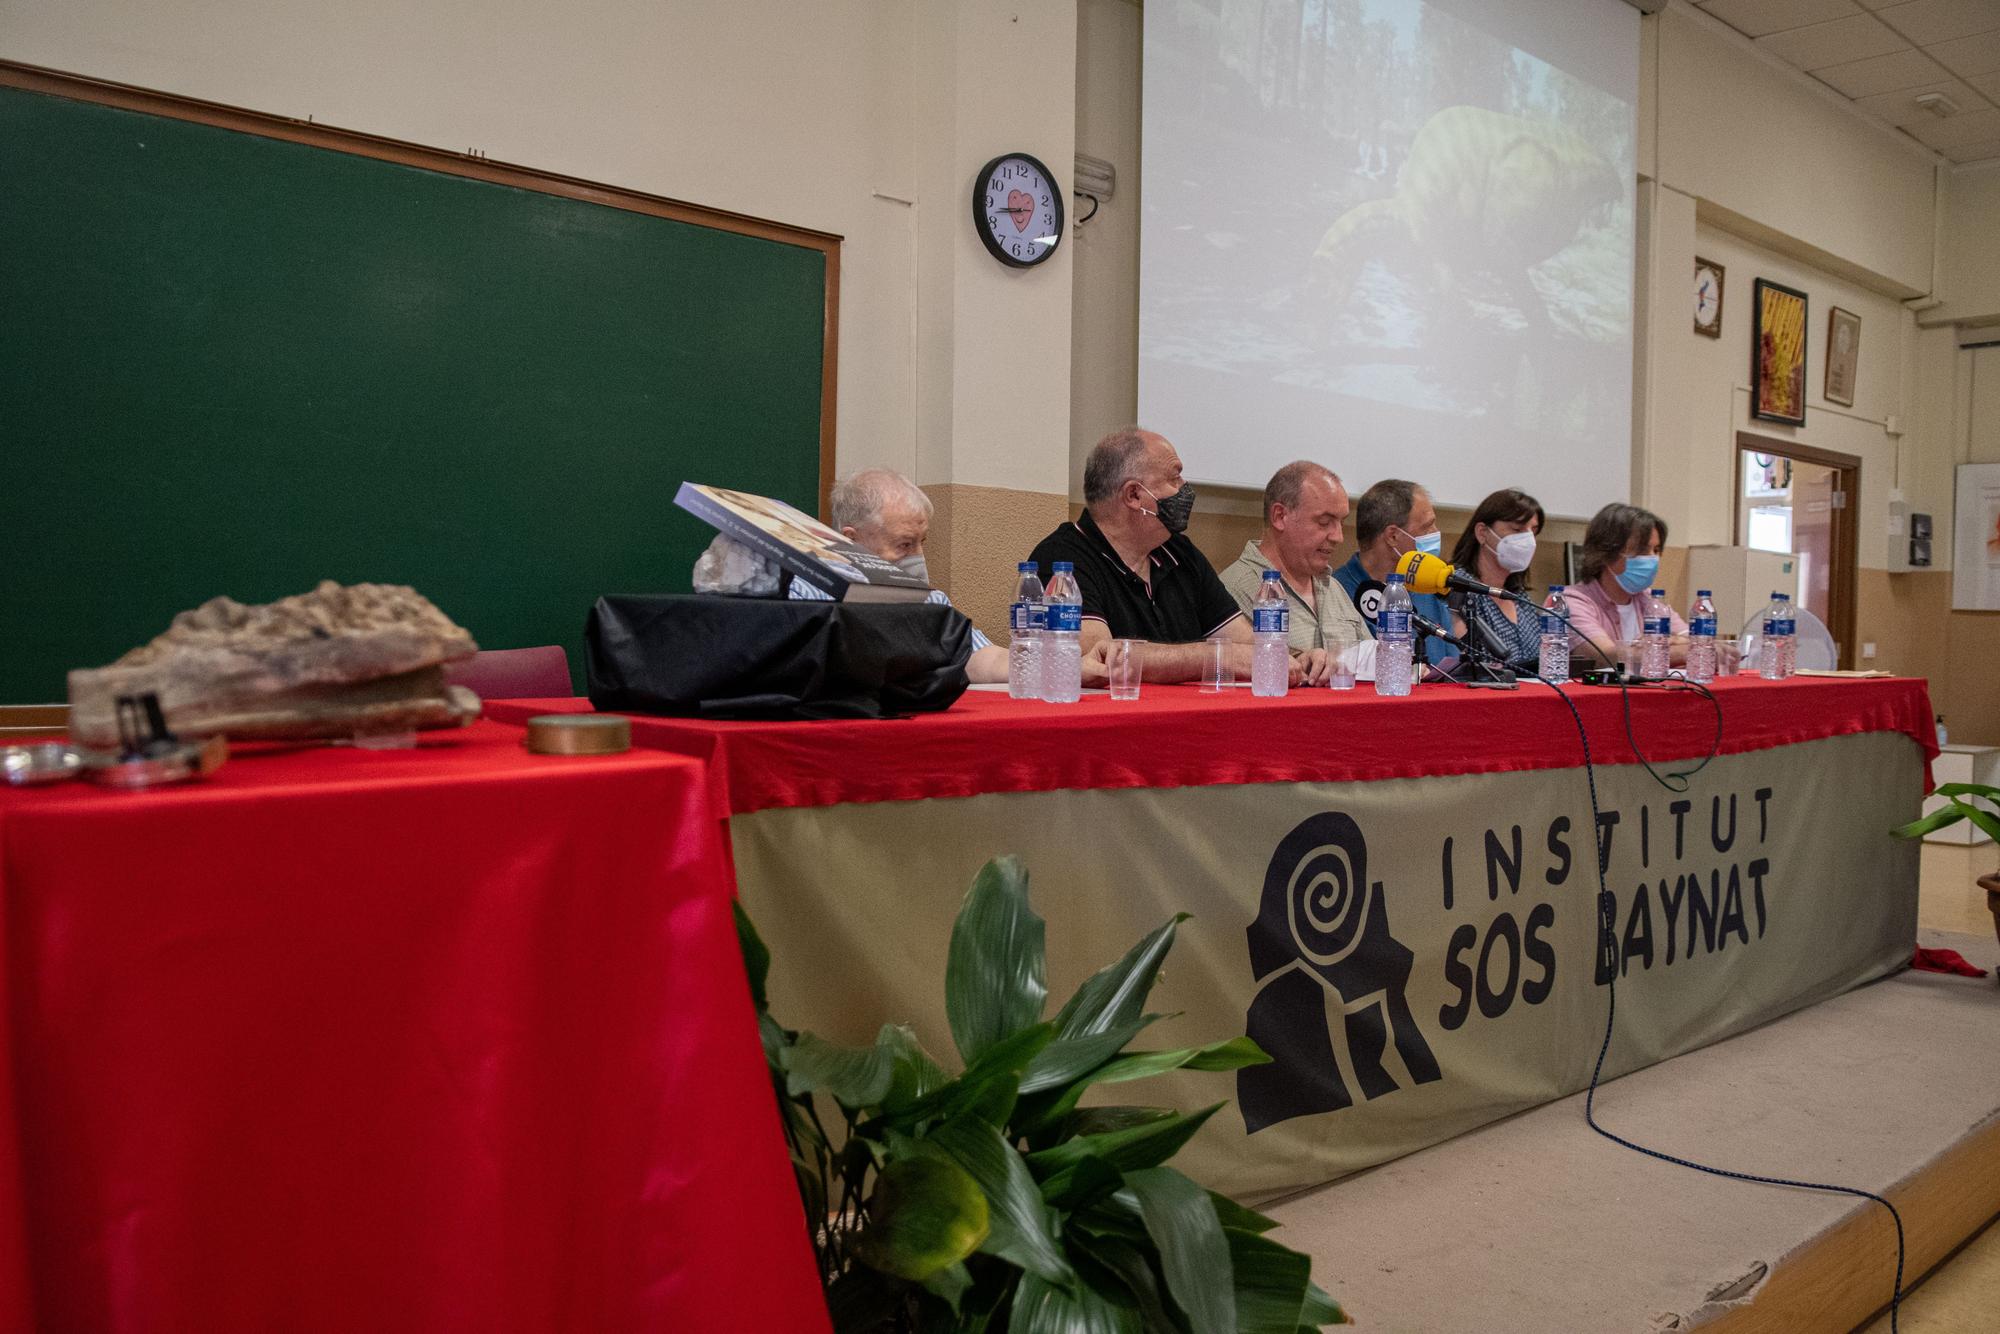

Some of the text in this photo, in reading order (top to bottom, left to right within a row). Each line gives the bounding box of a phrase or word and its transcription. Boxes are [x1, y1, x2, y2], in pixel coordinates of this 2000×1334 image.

[1002, 167, 1012, 179] 11
[1016, 165, 1028, 178] 12
[992, 179, 1004, 192] 10
[1033, 177, 1038, 188] 1
[985, 195, 994, 208] 9
[1041, 194, 1049, 207] 2
[988, 215, 997, 230] 8
[1043, 213, 1052, 226] 3
[998, 234, 1006, 247] 7
[1012, 243, 1021, 257] 6
[1027, 242, 1035, 255] 5
[1405, 553, 1426, 586] SER
[1441, 787, 1773, 910] INSTITUT
[1439, 858, 1770, 1031] SOS BAYNAT
